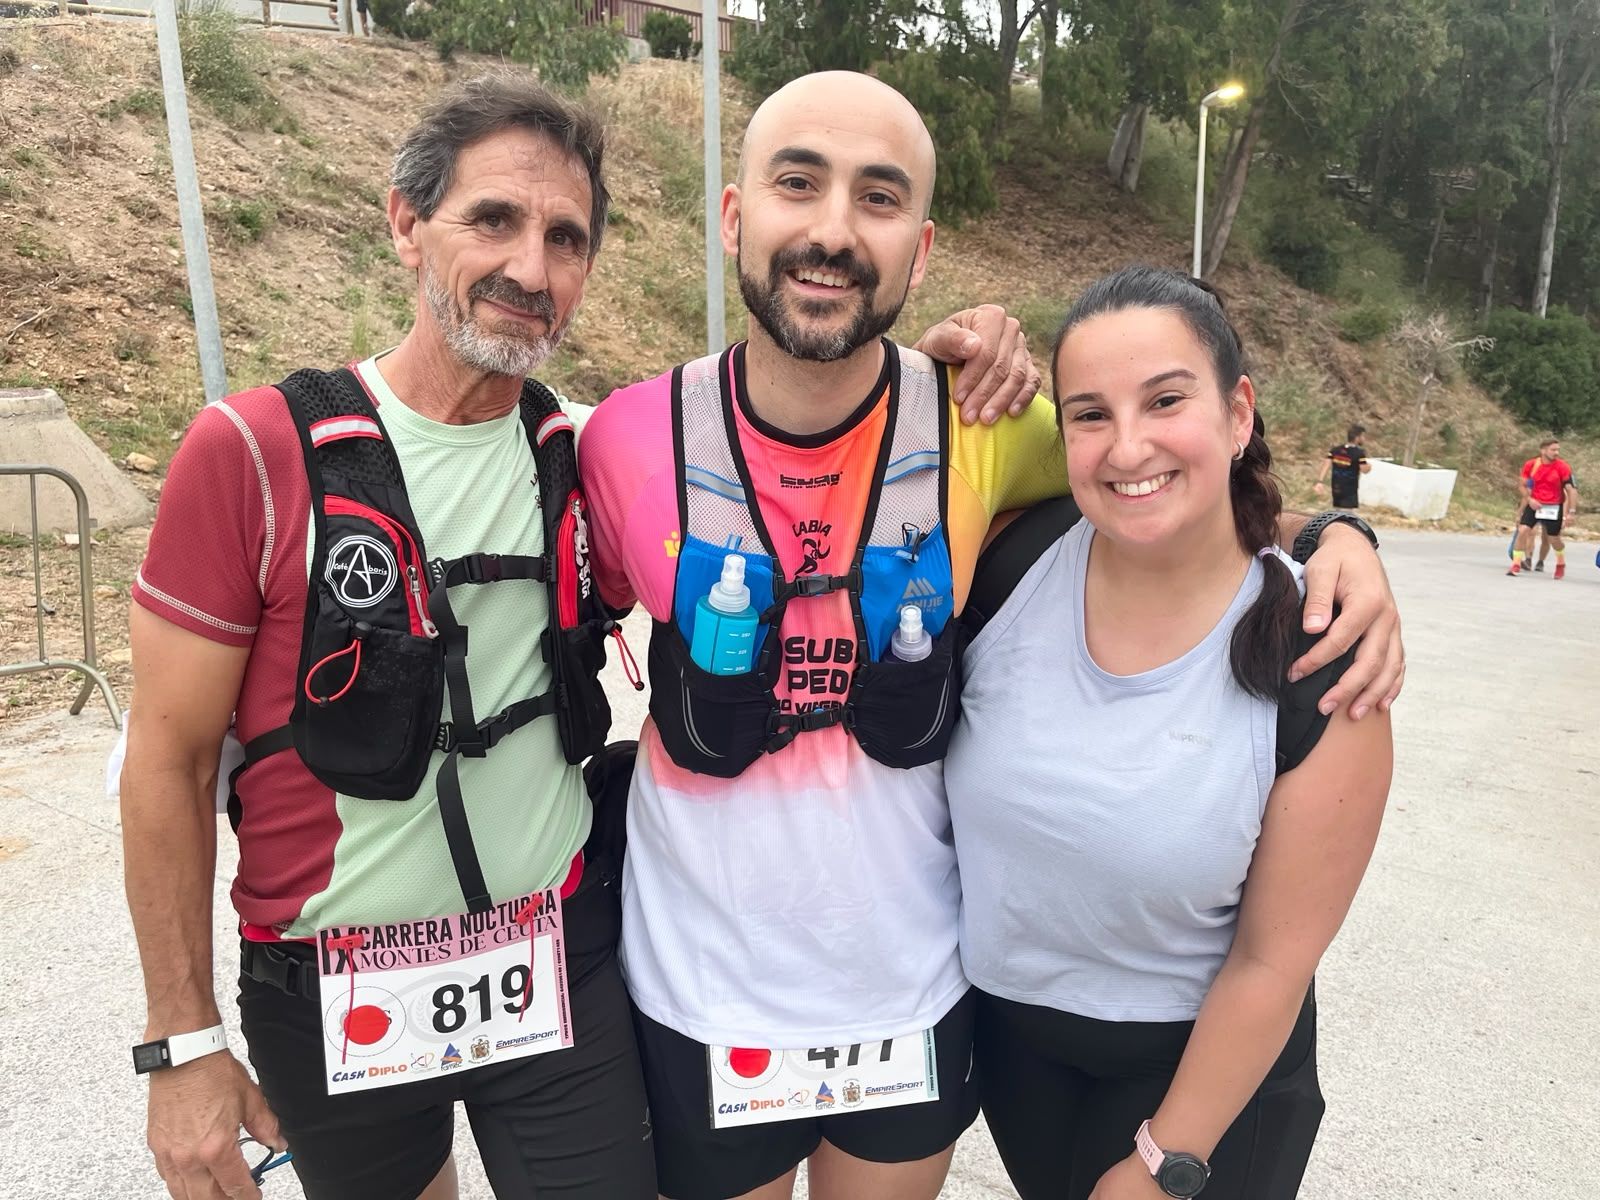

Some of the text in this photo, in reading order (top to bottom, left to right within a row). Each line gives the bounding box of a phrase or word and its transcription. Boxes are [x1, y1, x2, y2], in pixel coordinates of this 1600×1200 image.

[785, 636, 854, 664] SUB
[788, 668, 849, 695] PED
[358, 917, 454, 951] CARRERA
[360, 915, 558, 970] MONTES DE CEUTA
[432, 964, 534, 1034] 819
